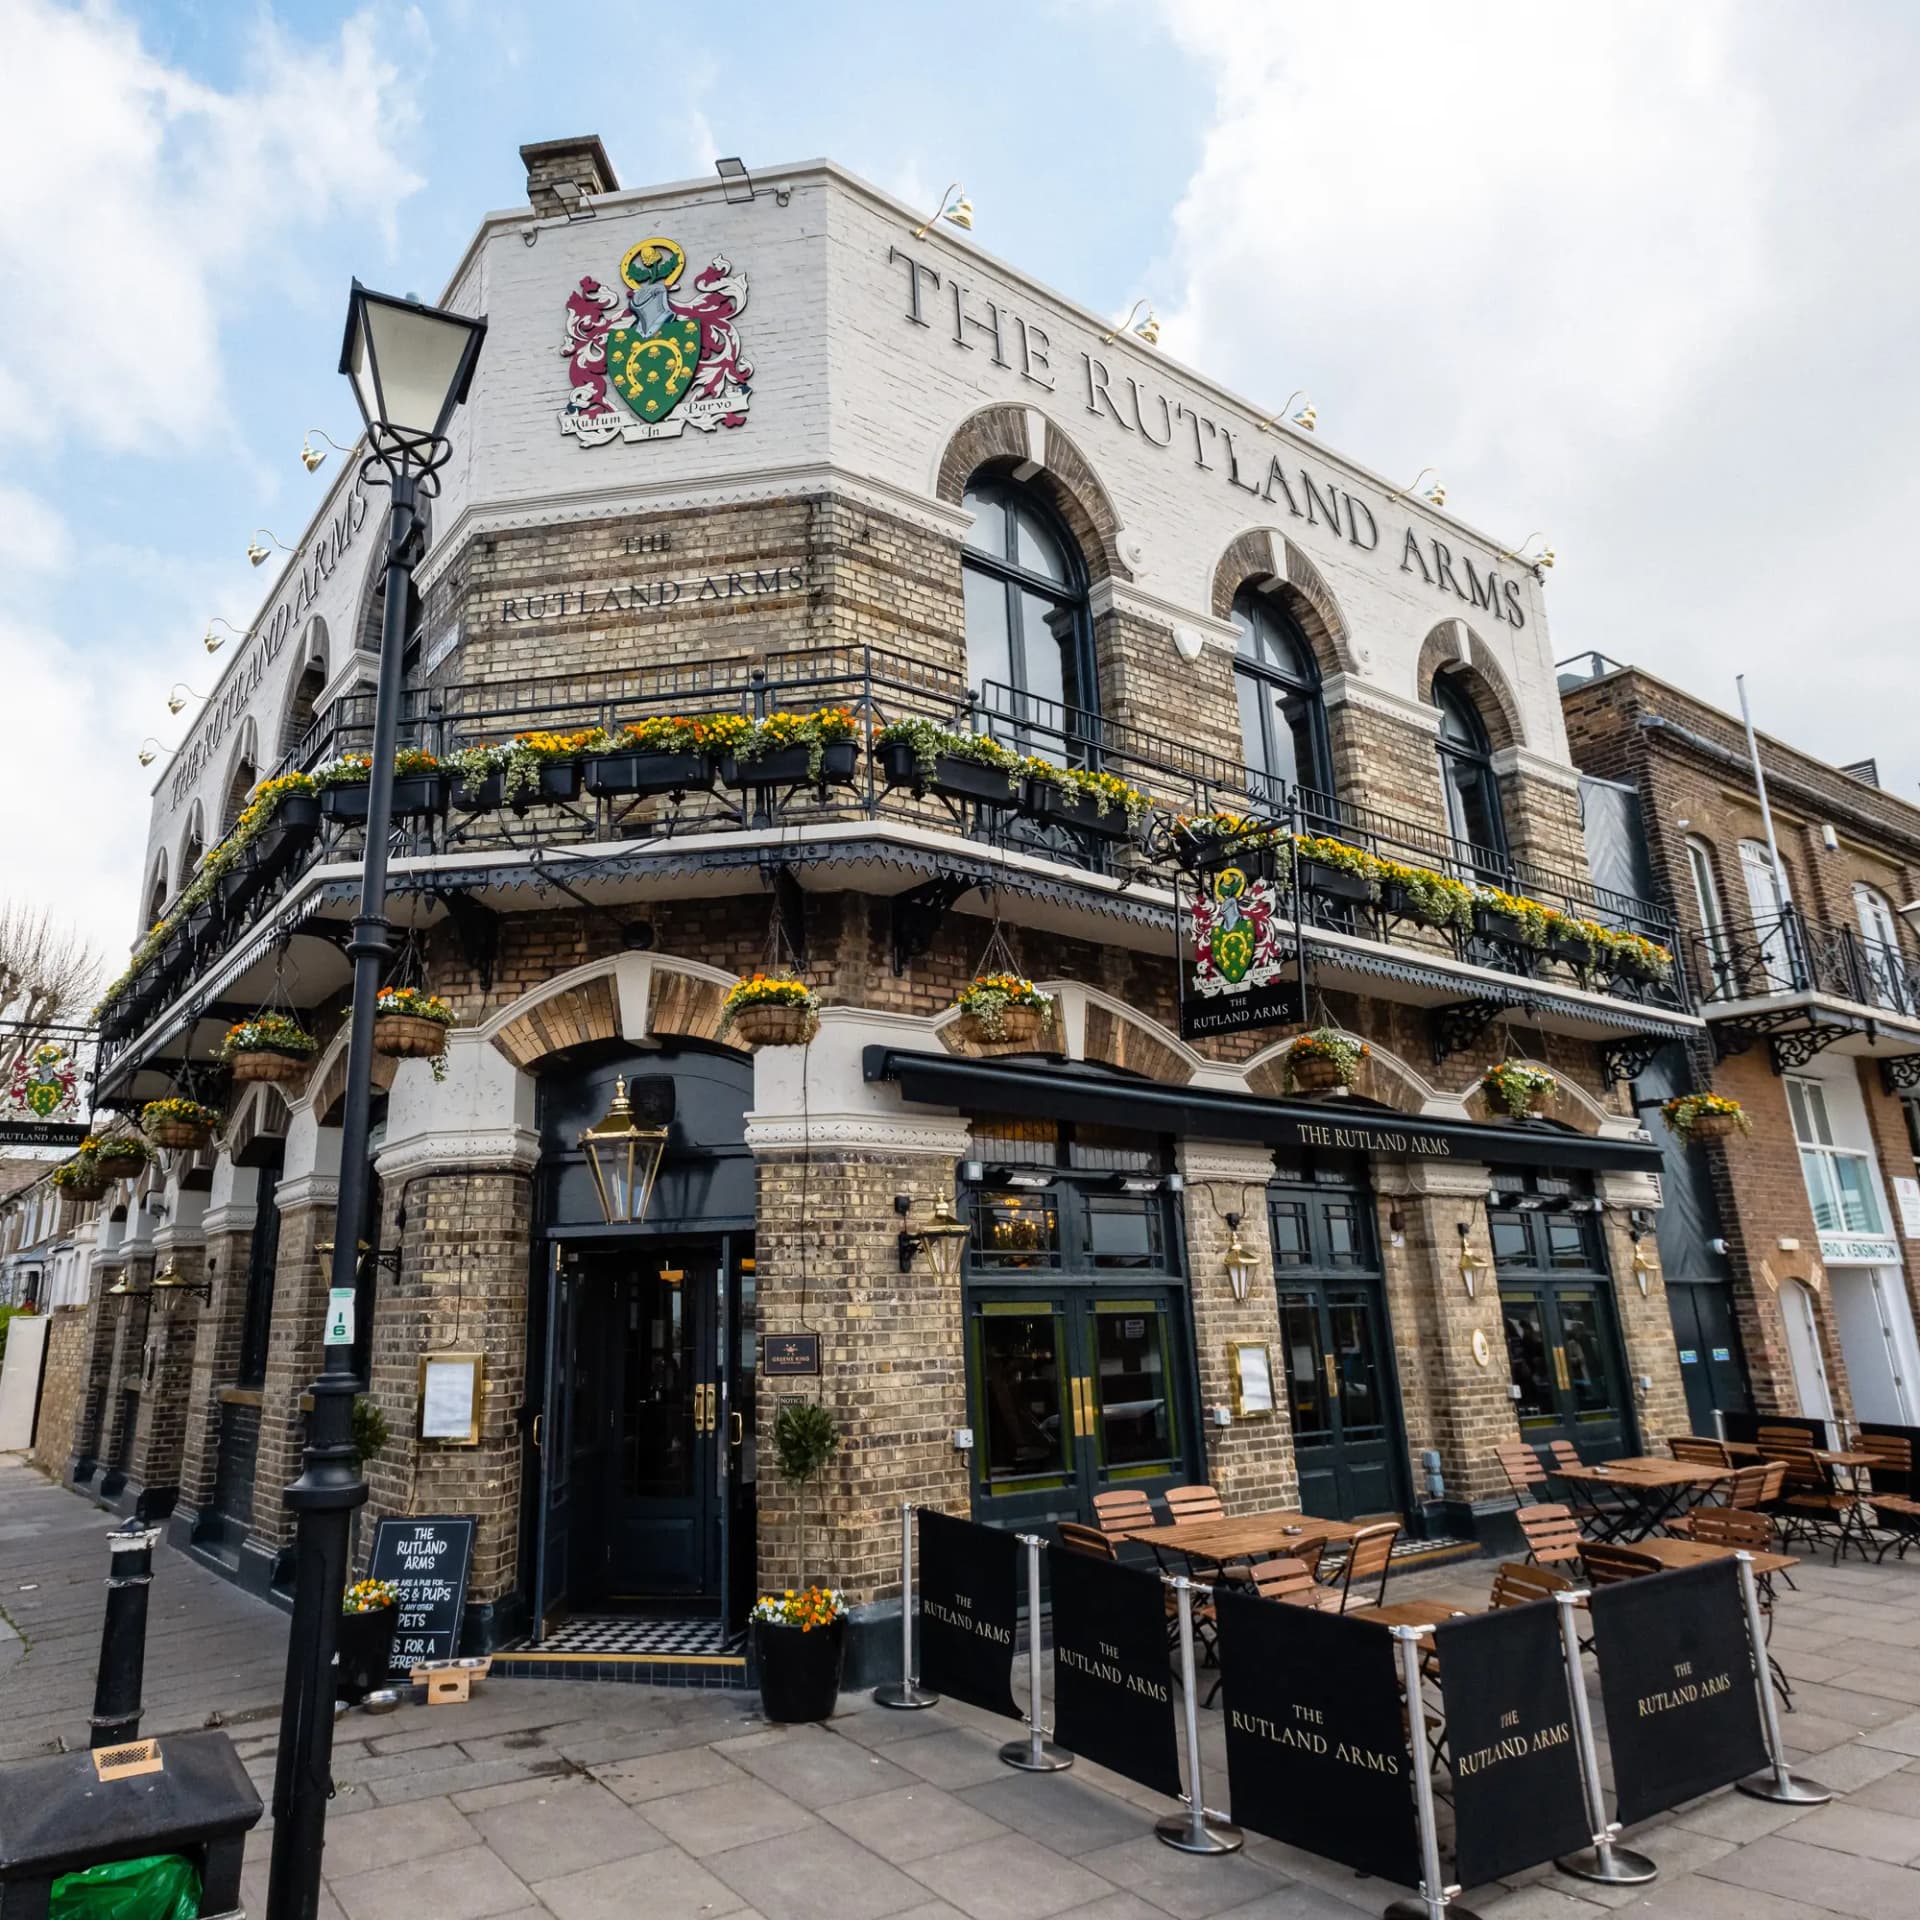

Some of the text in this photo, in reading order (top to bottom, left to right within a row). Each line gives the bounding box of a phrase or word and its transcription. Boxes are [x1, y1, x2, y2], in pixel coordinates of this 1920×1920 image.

[684, 400, 732, 415] Parvo
[889, 245, 1526, 630] THE RUTLAND ARMS
[620, 533, 672, 555] THE
[501, 565, 804, 623] RUTLAND ARMS
[171, 490, 367, 812] THE RUTLAND ARMS
[1230, 997, 1247, 1007] THE
[1193, 1003, 1289, 1029] RUTLAND ARMS
[51, 1134, 80, 1143] ARMS
[1297, 1124, 1450, 1156] THE RUTLAND ARMS
[333, 1325, 346, 1336] 6
[414, 1528, 435, 1540] THE
[397, 1540, 448, 1556] RUTLAND
[404, 1556, 435, 1570] ARMS
[432, 1579, 444, 1587] FOR
[422, 1588, 451, 1601] PUPS
[955, 1593, 972, 1609] THE
[398, 1613, 426, 1627] PETS
[924, 1599, 1010, 1645] RUTLAND ARMS
[404, 1639, 424, 1653] FOR
[426, 1638, 435, 1654] A
[1099, 1641, 1119, 1659] THE
[1059, 1647, 1168, 1702] RUTLAND ARMS
[1674, 1661, 1693, 1678] THE
[1638, 1673, 1732, 1717] RUTLAND ARMS
[1292, 1704, 1324, 1725] THE
[1500, 1709, 1520, 1728] THE
[1232, 1710, 1399, 1775] RUTLAND ARMS
[1459, 1722, 1570, 1776] RUTLAND ARMS
